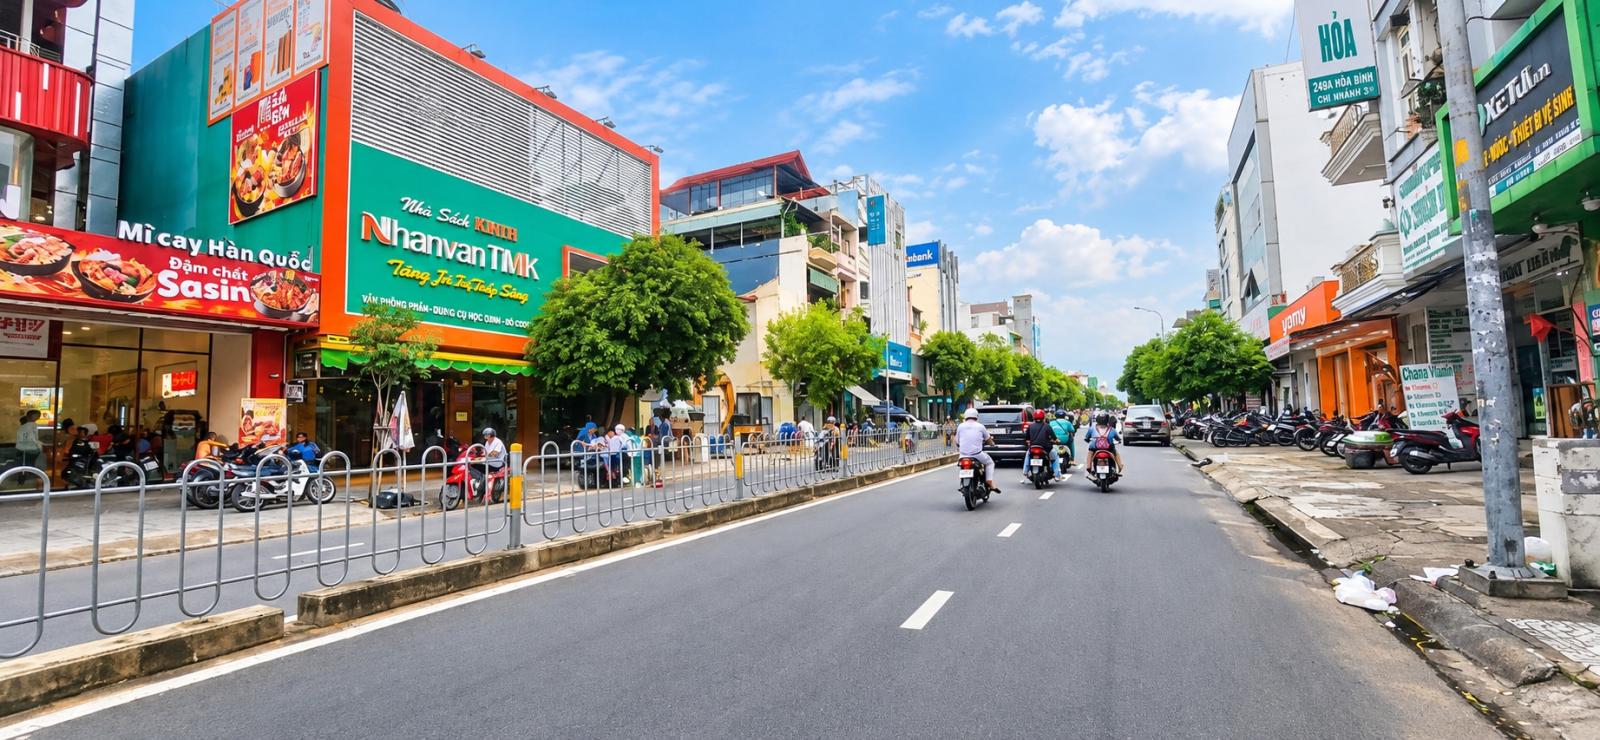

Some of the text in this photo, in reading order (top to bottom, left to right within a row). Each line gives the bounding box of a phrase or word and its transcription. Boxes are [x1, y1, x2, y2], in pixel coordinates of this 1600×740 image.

[1313, 80, 1333, 93] 249A
[1318, 94, 1331, 103] CHI
[401, 197, 432, 217] Nhà
[437, 208, 470, 228] Sách
[118, 219, 156, 244] Mì
[157, 232, 203, 257] cay
[208, 239, 254, 262] Hàn
[168, 256, 208, 276] Đậm
[157, 269, 252, 302] Sasin
[1282, 306, 1306, 337] yamy
